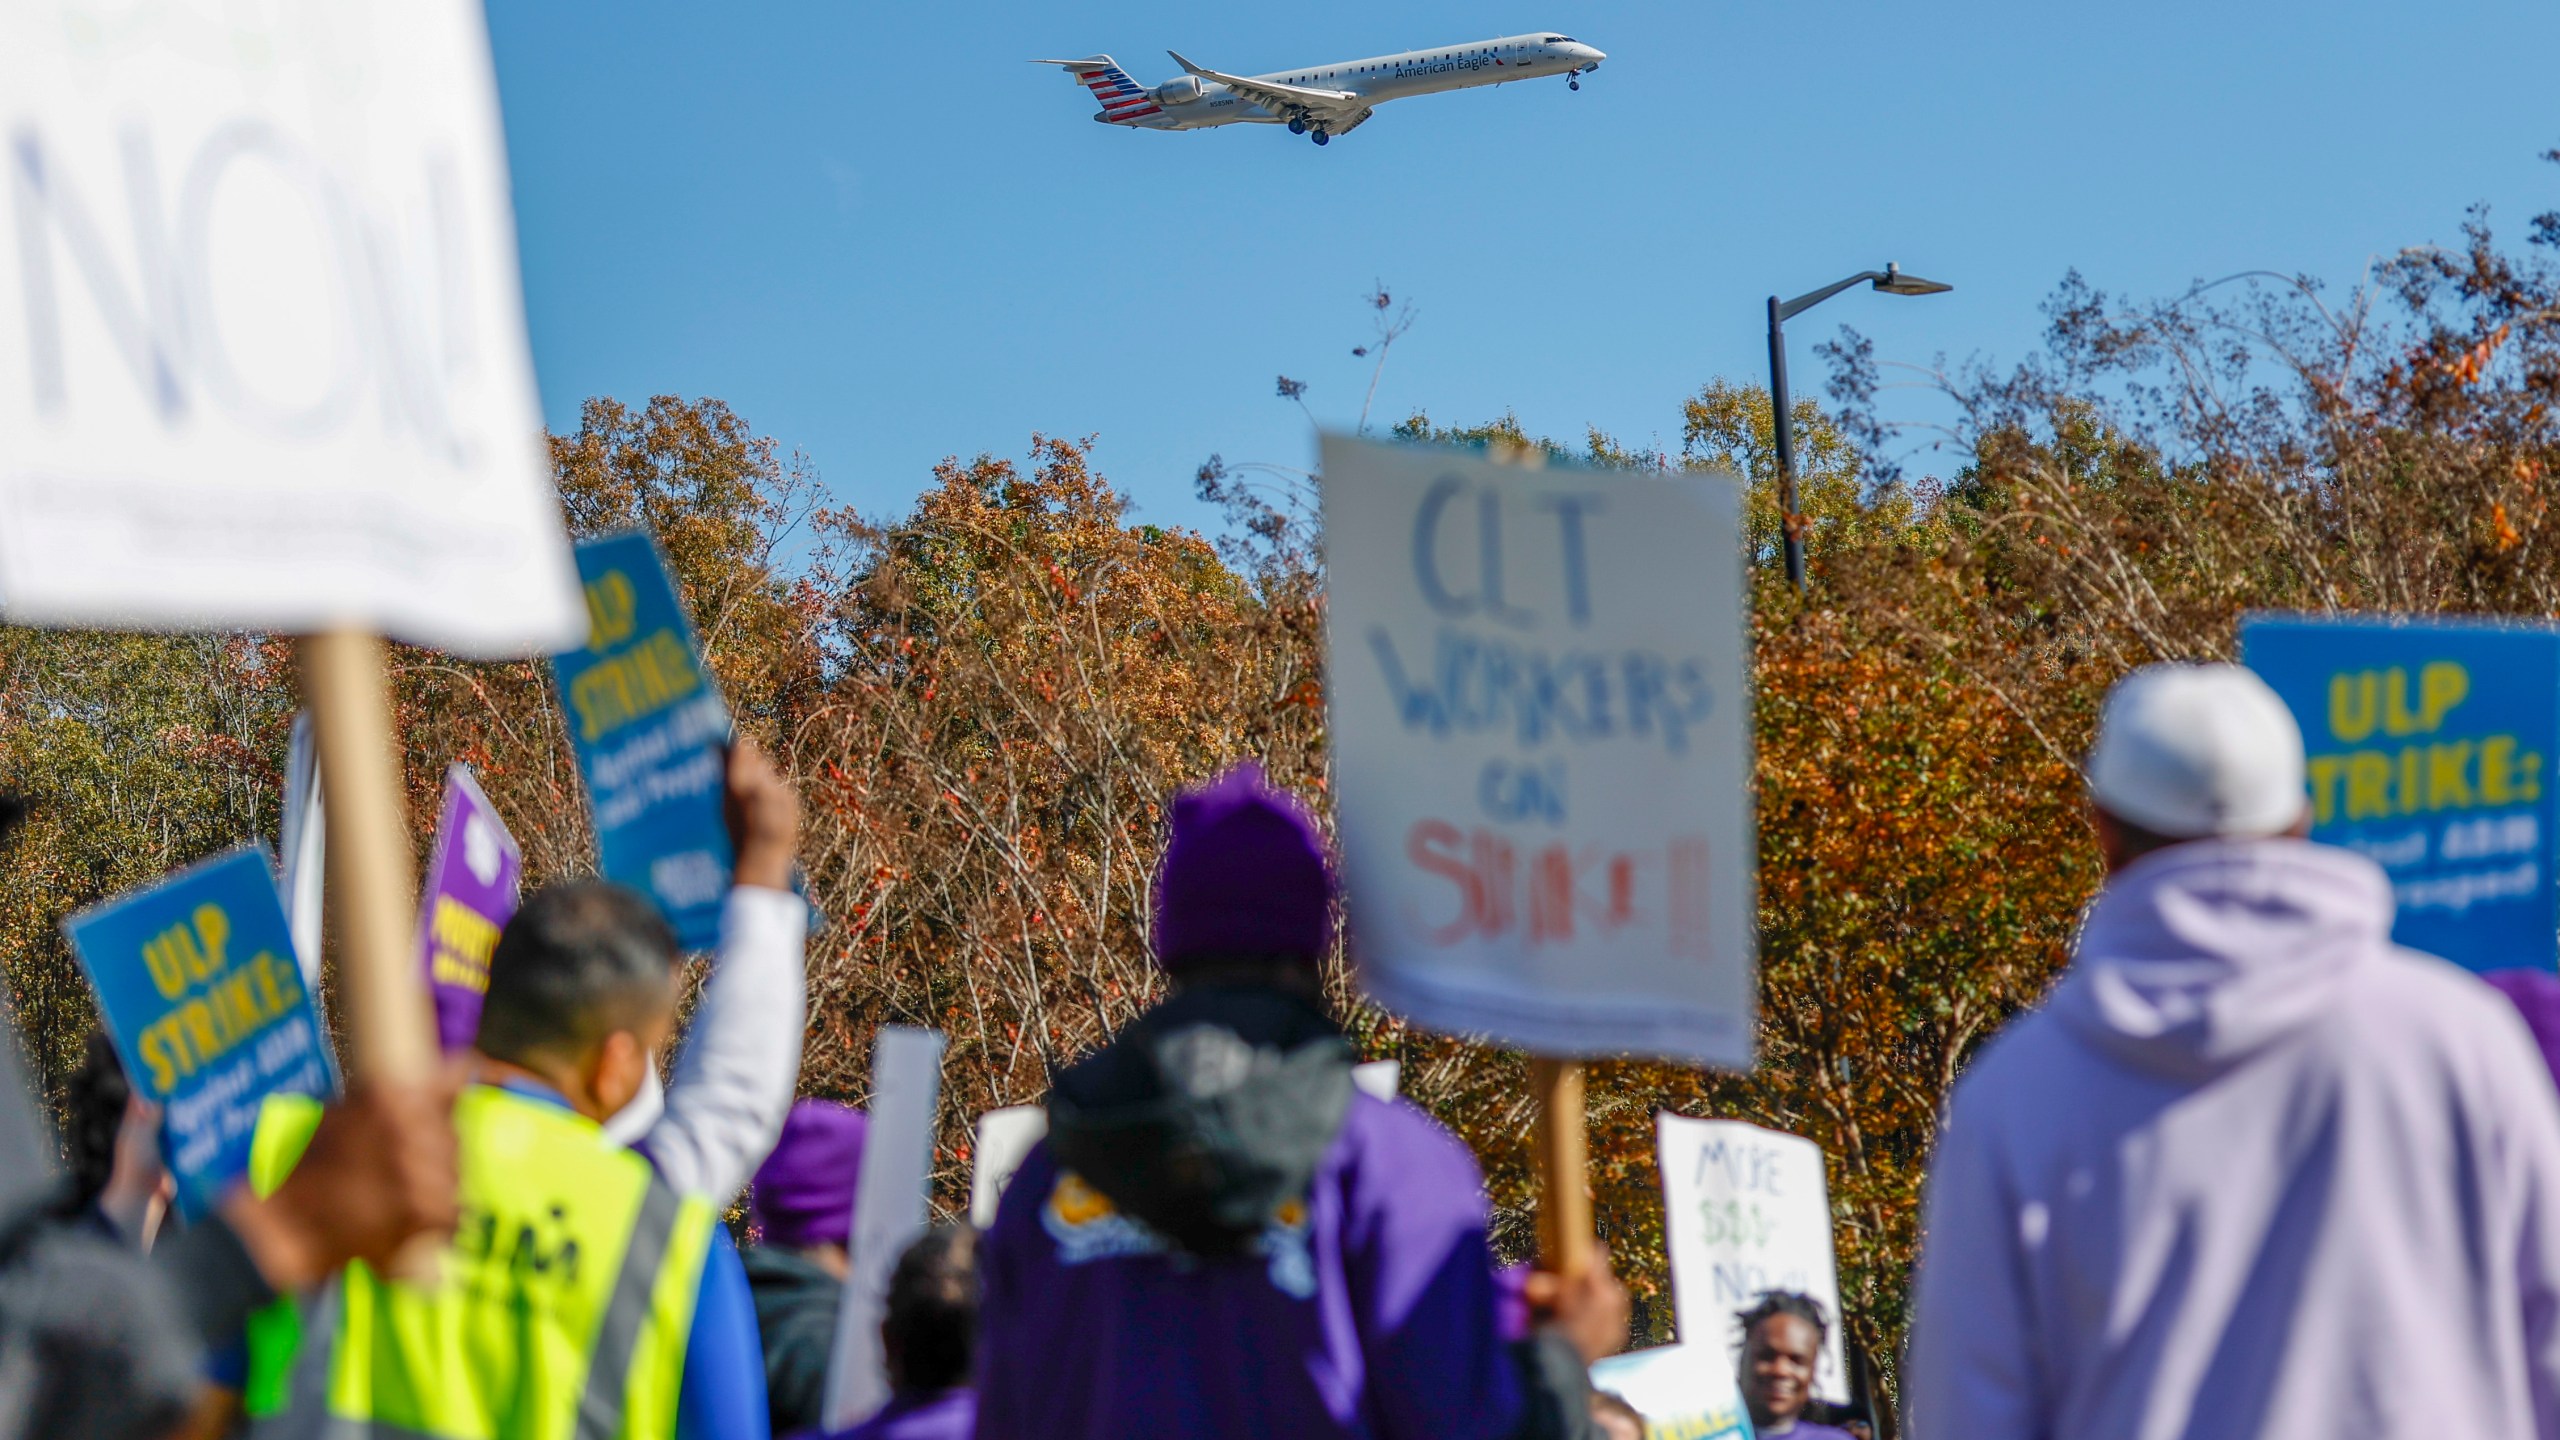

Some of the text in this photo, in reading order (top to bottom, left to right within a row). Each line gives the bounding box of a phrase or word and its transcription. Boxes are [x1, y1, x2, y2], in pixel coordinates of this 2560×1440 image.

[1395, 55, 1489, 79] American Eagle
[1413, 472, 1608, 632] CLT
[1366, 622, 1714, 756] WORKERS
[2327, 660, 2470, 744] ULP
[1476, 756, 1569, 826] ON
[2305, 732, 2542, 826] TRIKE:
[140, 902, 231, 1000] ULP
[137, 950, 302, 1094] STRIKE:
